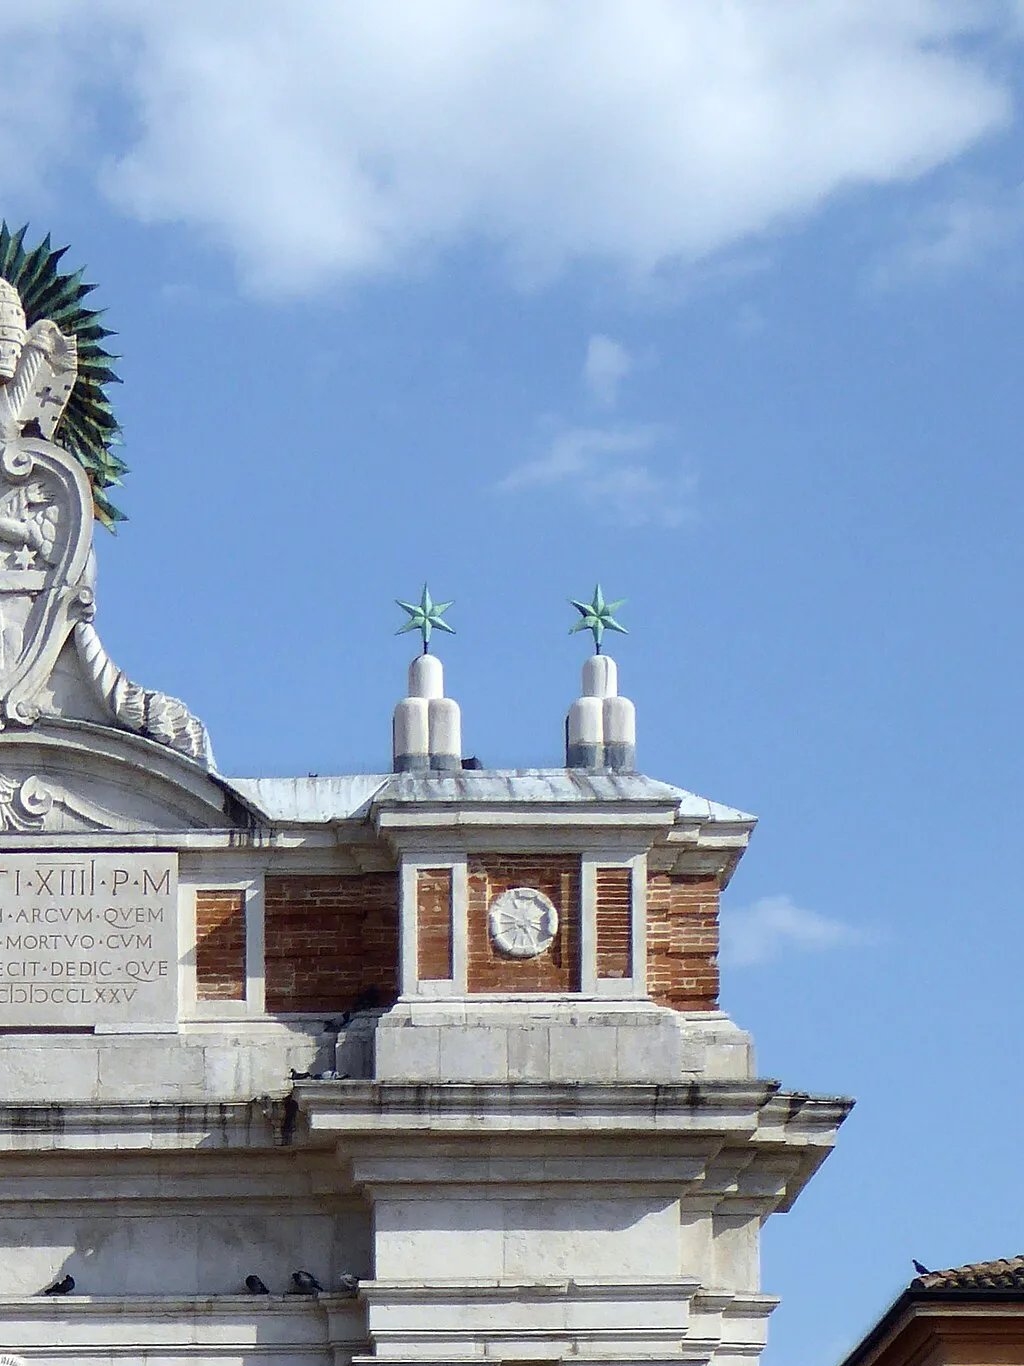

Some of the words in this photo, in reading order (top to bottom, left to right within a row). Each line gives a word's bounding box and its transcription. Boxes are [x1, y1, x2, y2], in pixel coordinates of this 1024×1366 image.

[35, 860, 95, 896] XIIII
[112, 869, 129, 896] P
[143, 869, 171, 895] M
[15, 907, 93, 923] ARCVM
[103, 907, 164, 929] QVEM
[6, 934, 94, 950] MORTVO
[106, 934, 152, 949] CVM
[51, 961, 112, 976] DEDIC
[125, 960, 168, 982] QVE
